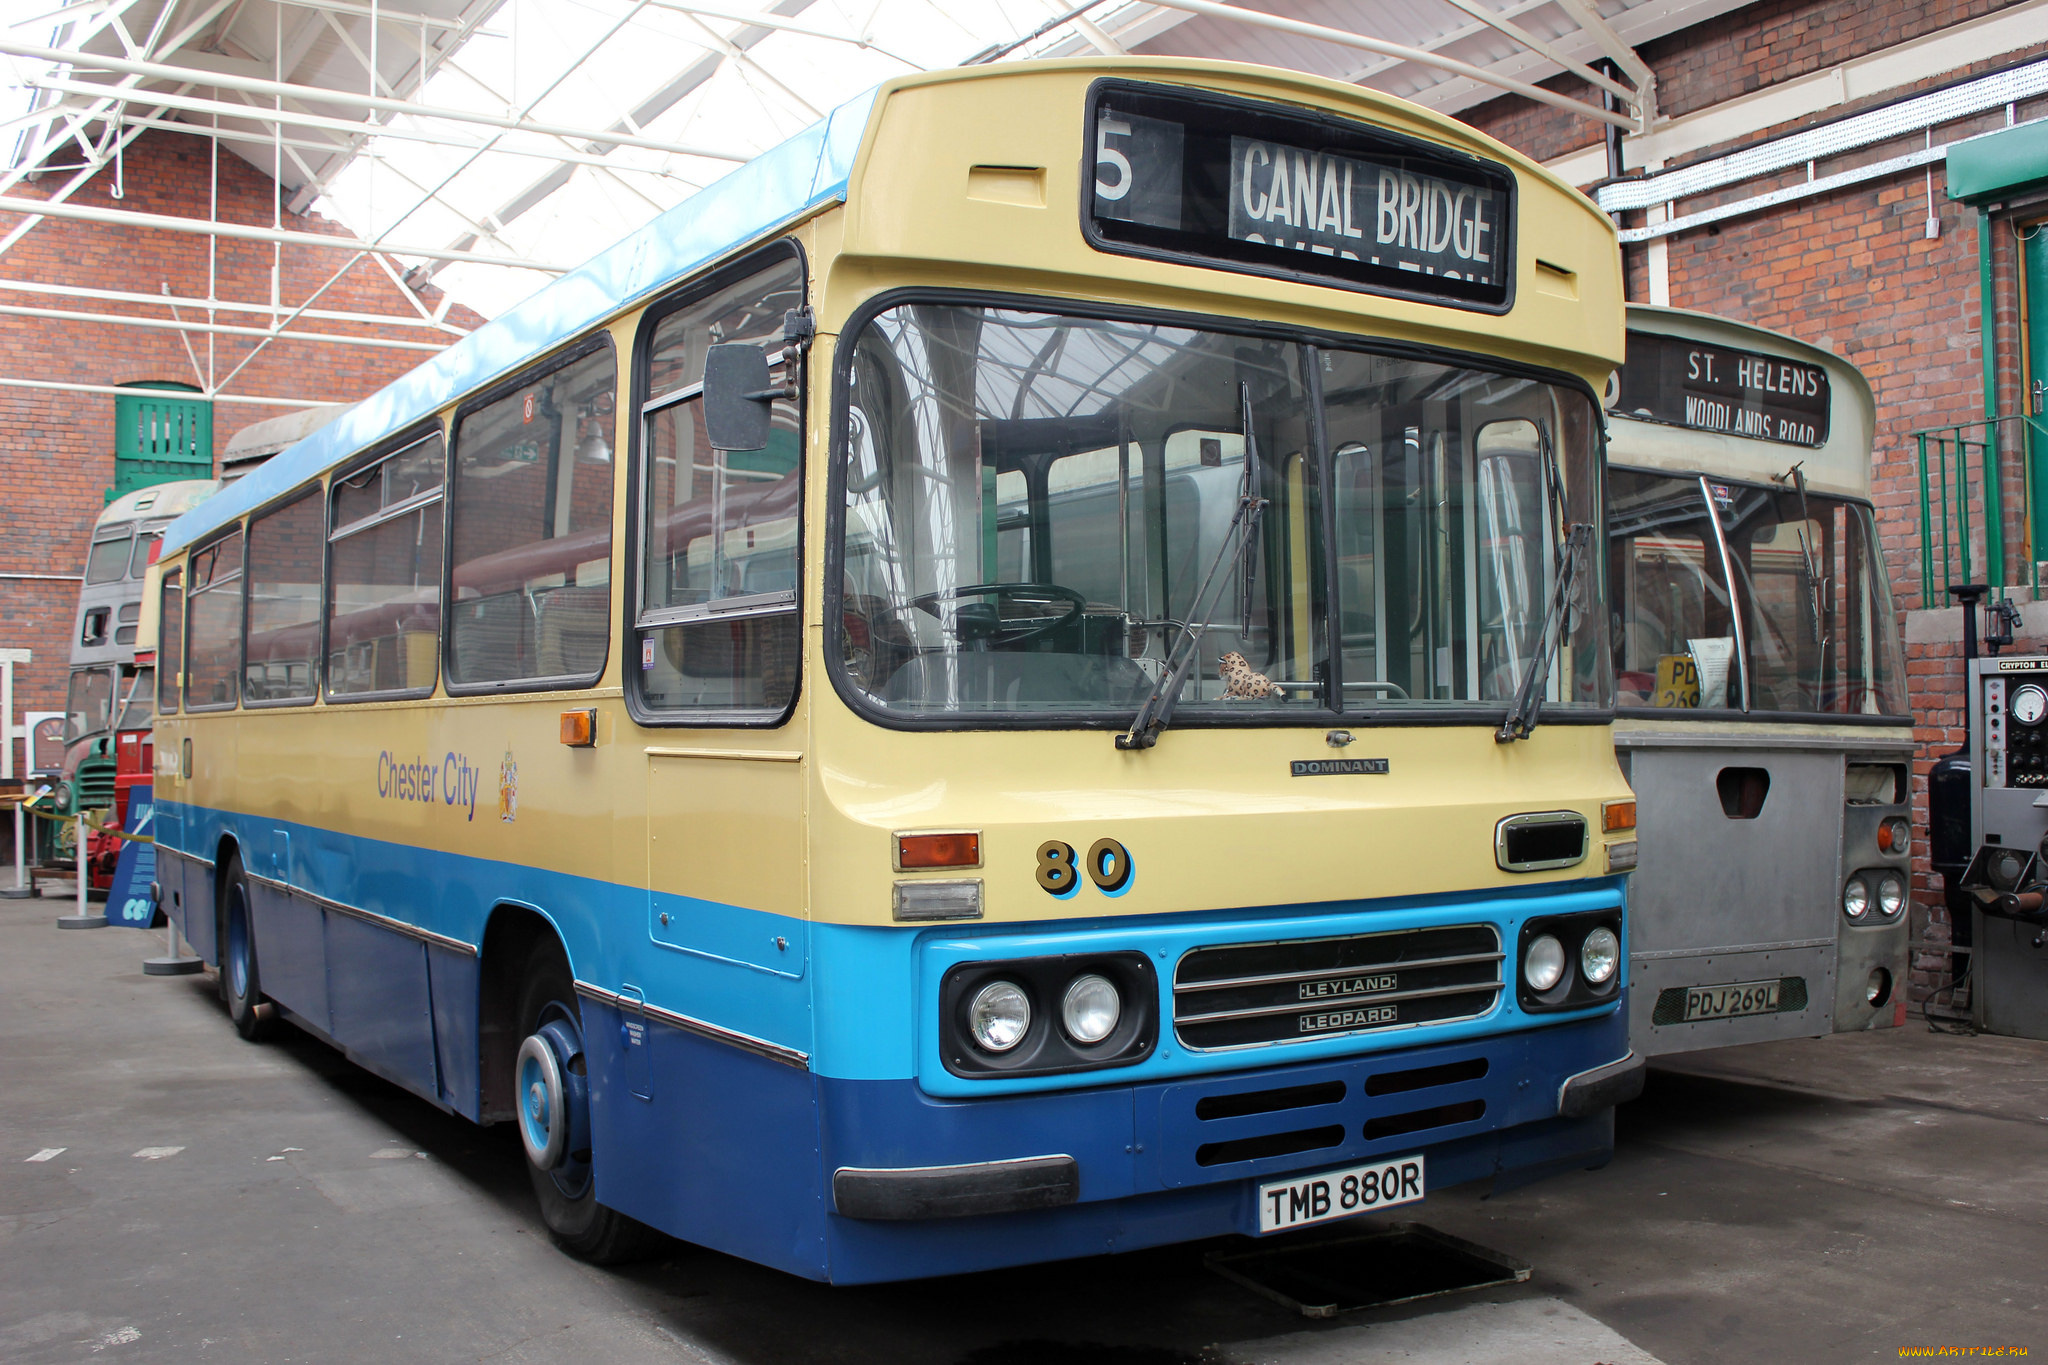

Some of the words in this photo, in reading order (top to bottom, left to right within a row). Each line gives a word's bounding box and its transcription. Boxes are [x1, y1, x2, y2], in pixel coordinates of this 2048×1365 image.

[1096, 120, 1132, 200] 5
[1243, 142, 1362, 238] CANAL
[1377, 168, 1489, 262] BRIDGE
[1687, 351, 1719, 383] ST.
[1737, 358, 1818, 397] HELENS
[1672, 661, 1697, 685] PD
[2000, 661, 2036, 670] CRYPTON
[1664, 690, 1701, 708] 269
[1294, 761, 1386, 774] DOMINANT
[378, 750, 438, 802] Chester
[443, 752, 479, 822] City
[1036, 838, 1136, 900] 80
[1306, 976, 1391, 997] LEYLAND
[1686, 991, 1726, 1020] PDJ
[1729, 986, 1776, 1014] 269L
[1306, 1008, 1392, 1029] LEOPARD
[1267, 1180, 1331, 1225] TMB
[1340, 1162, 1420, 1210] 880R
